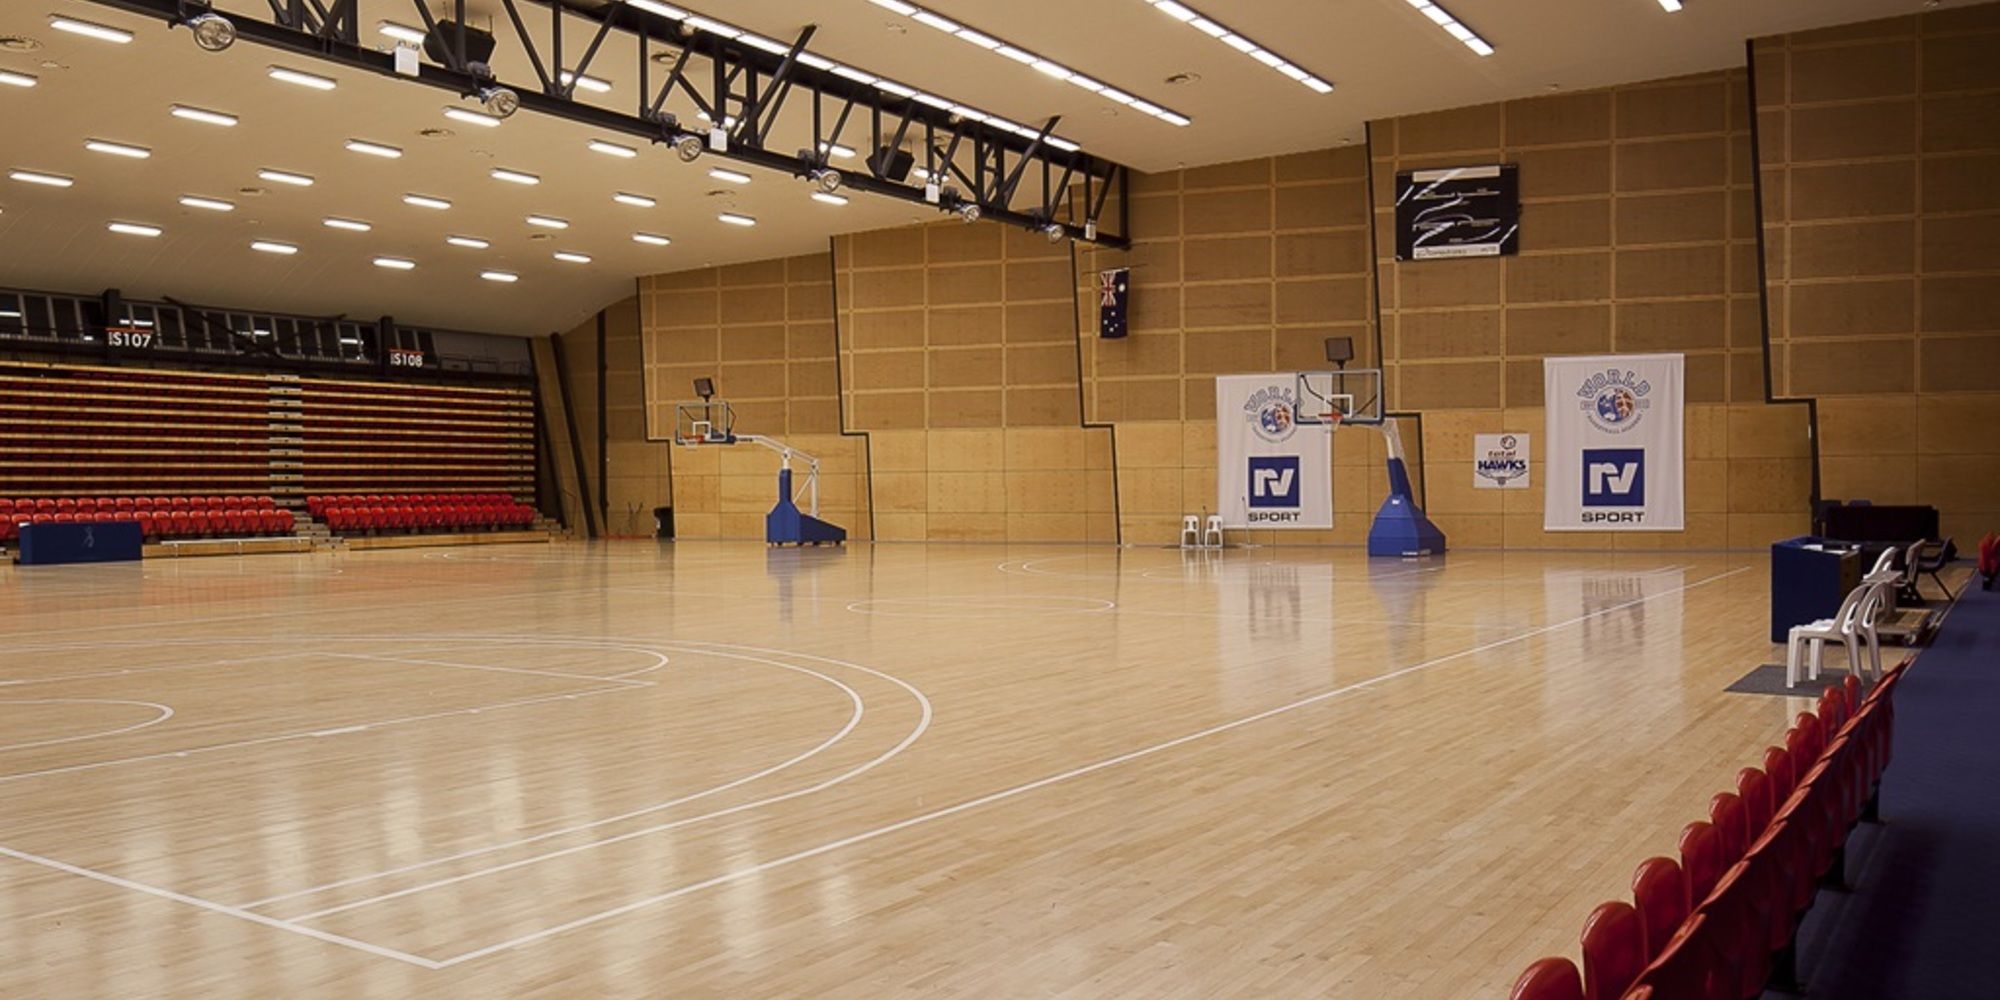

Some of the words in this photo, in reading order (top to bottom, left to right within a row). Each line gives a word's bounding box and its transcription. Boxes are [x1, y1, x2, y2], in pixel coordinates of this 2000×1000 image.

[1577, 369, 1651, 399] WORLD
[1478, 460, 1526, 471] HAWKS
[1248, 512, 1300, 522] SPORT
[1581, 511, 1645, 523] SPORT
